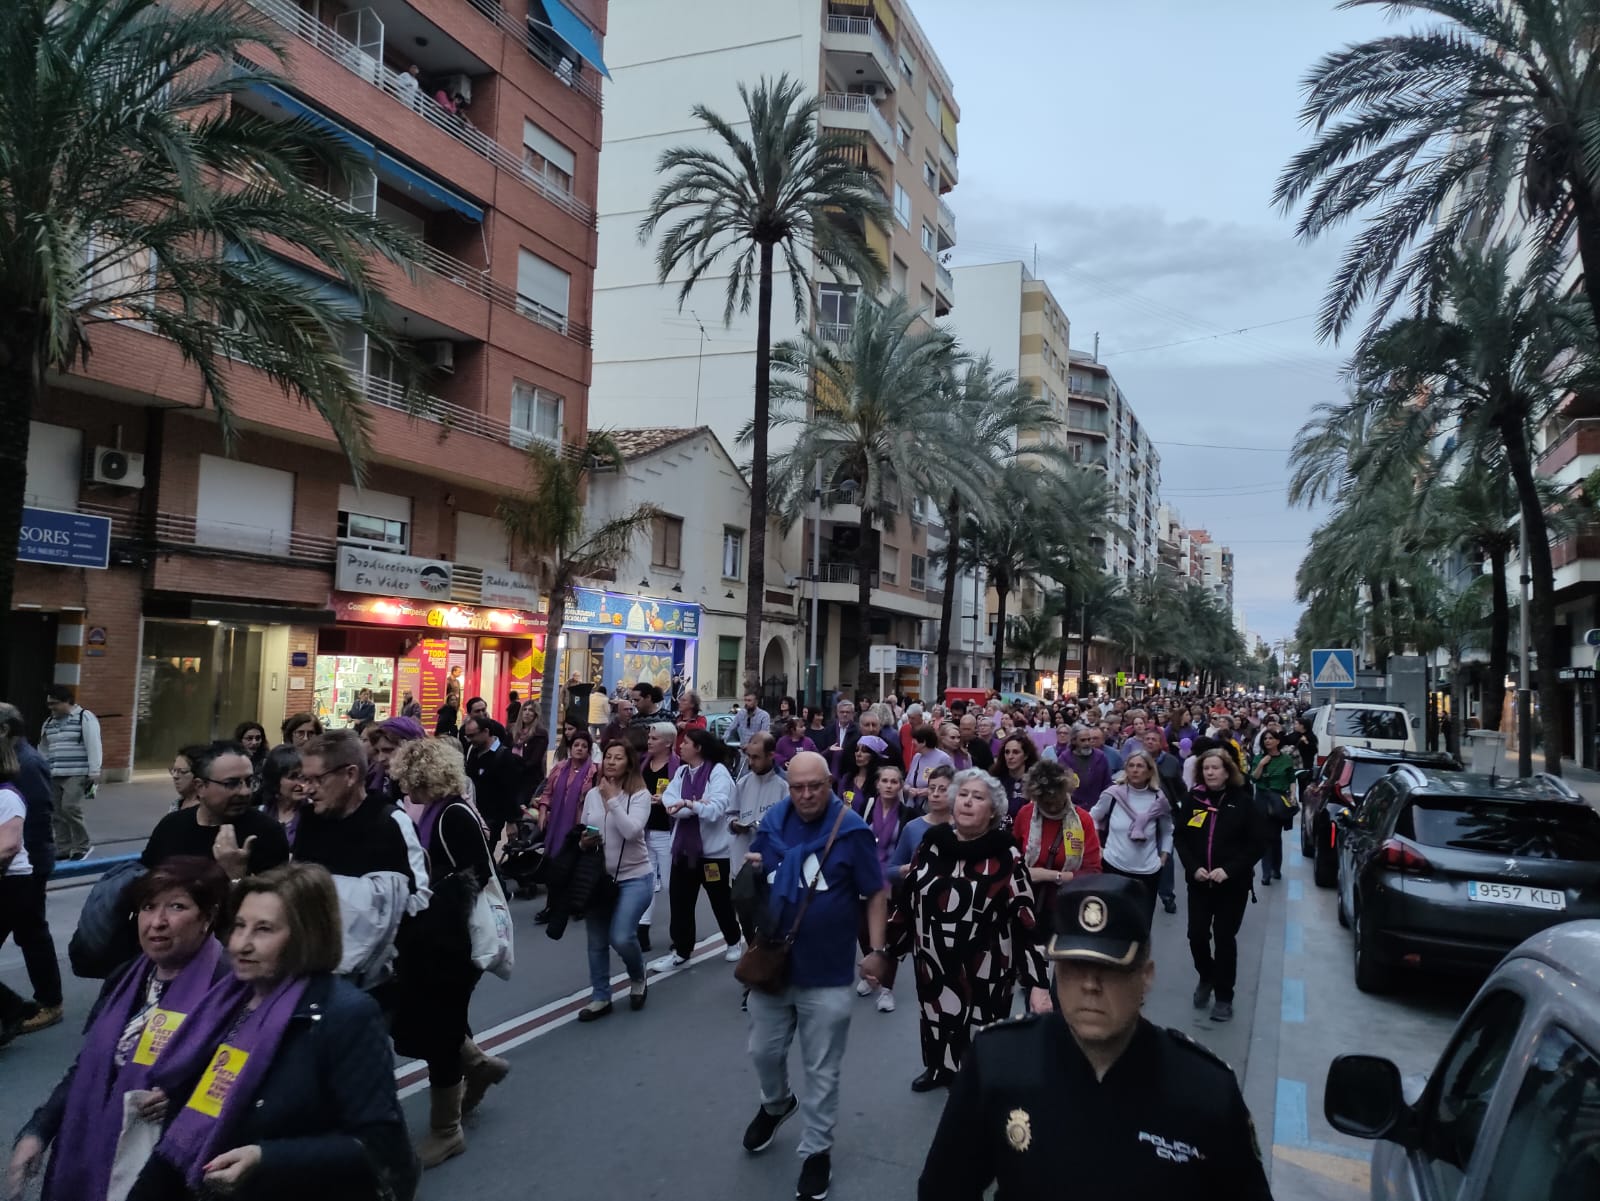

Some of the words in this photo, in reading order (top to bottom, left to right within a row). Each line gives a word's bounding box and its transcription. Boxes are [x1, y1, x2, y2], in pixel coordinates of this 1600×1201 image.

[355, 573, 372, 586] En
[1578, 670, 1595, 679] BAR
[1479, 883, 1522, 900] 9557
[1530, 888, 1561, 905] KLD
[1138, 1131, 1200, 1160] POLICIA
